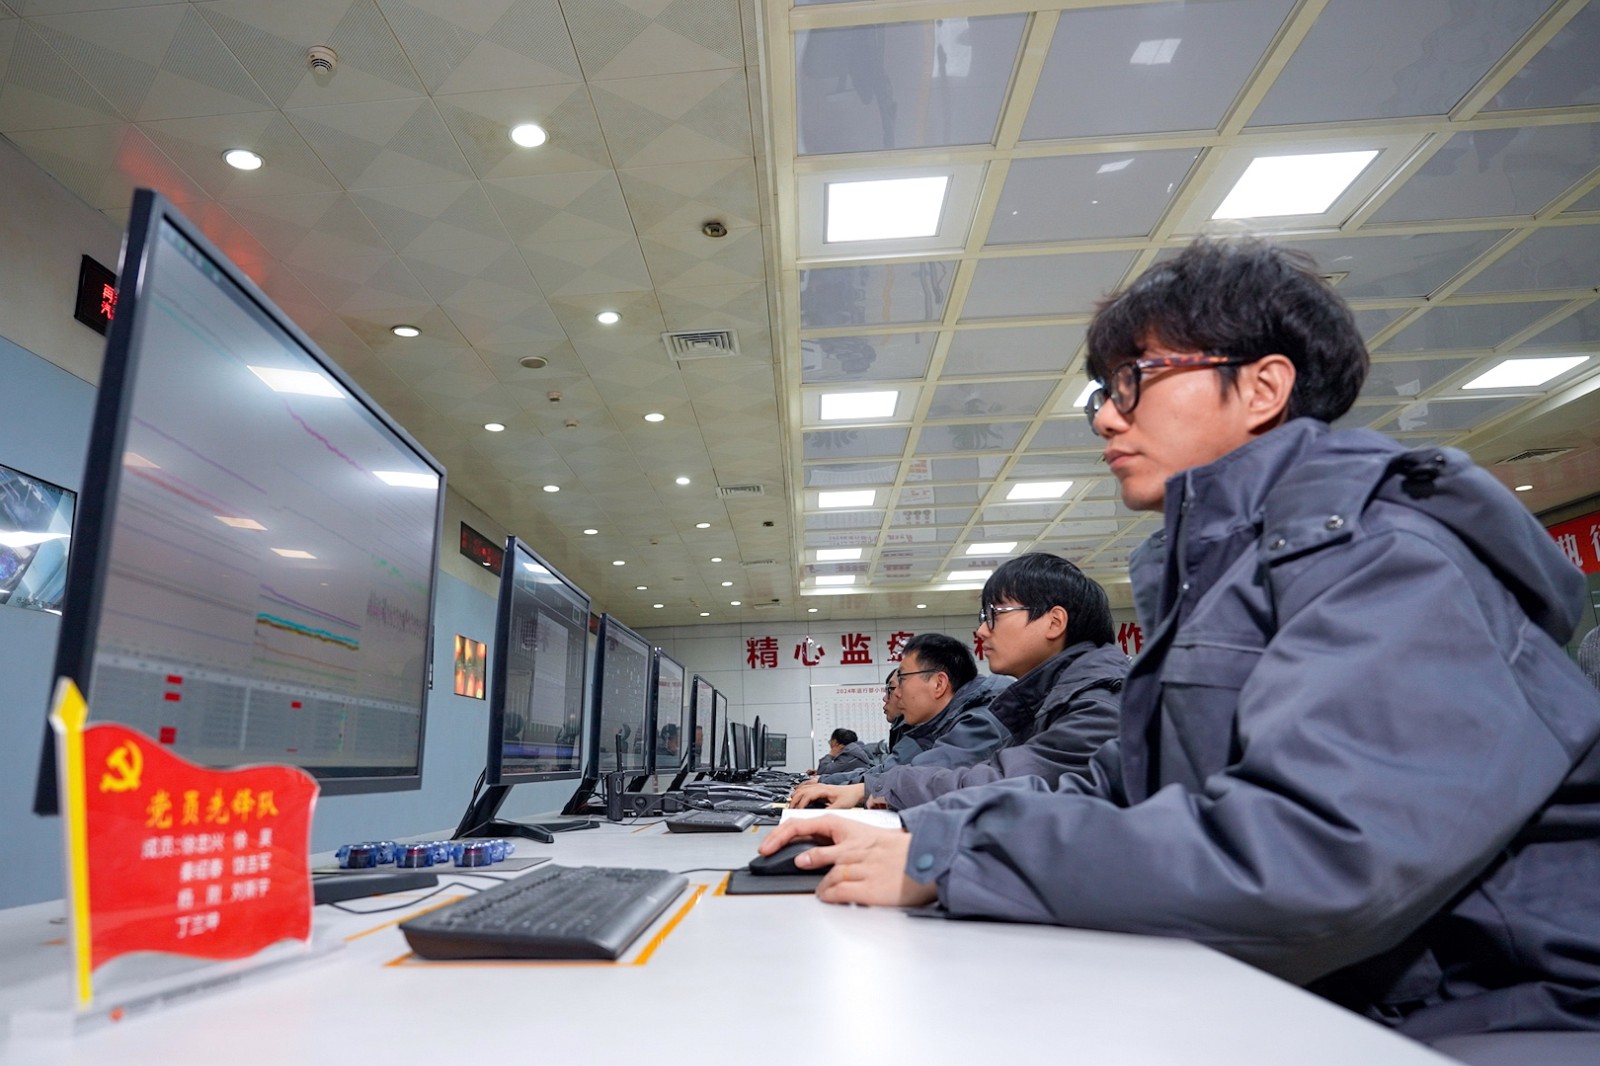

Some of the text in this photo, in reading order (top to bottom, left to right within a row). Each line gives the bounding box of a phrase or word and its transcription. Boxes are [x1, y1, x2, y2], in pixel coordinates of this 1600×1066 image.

[145, 787, 279, 829] 党员先锋队
